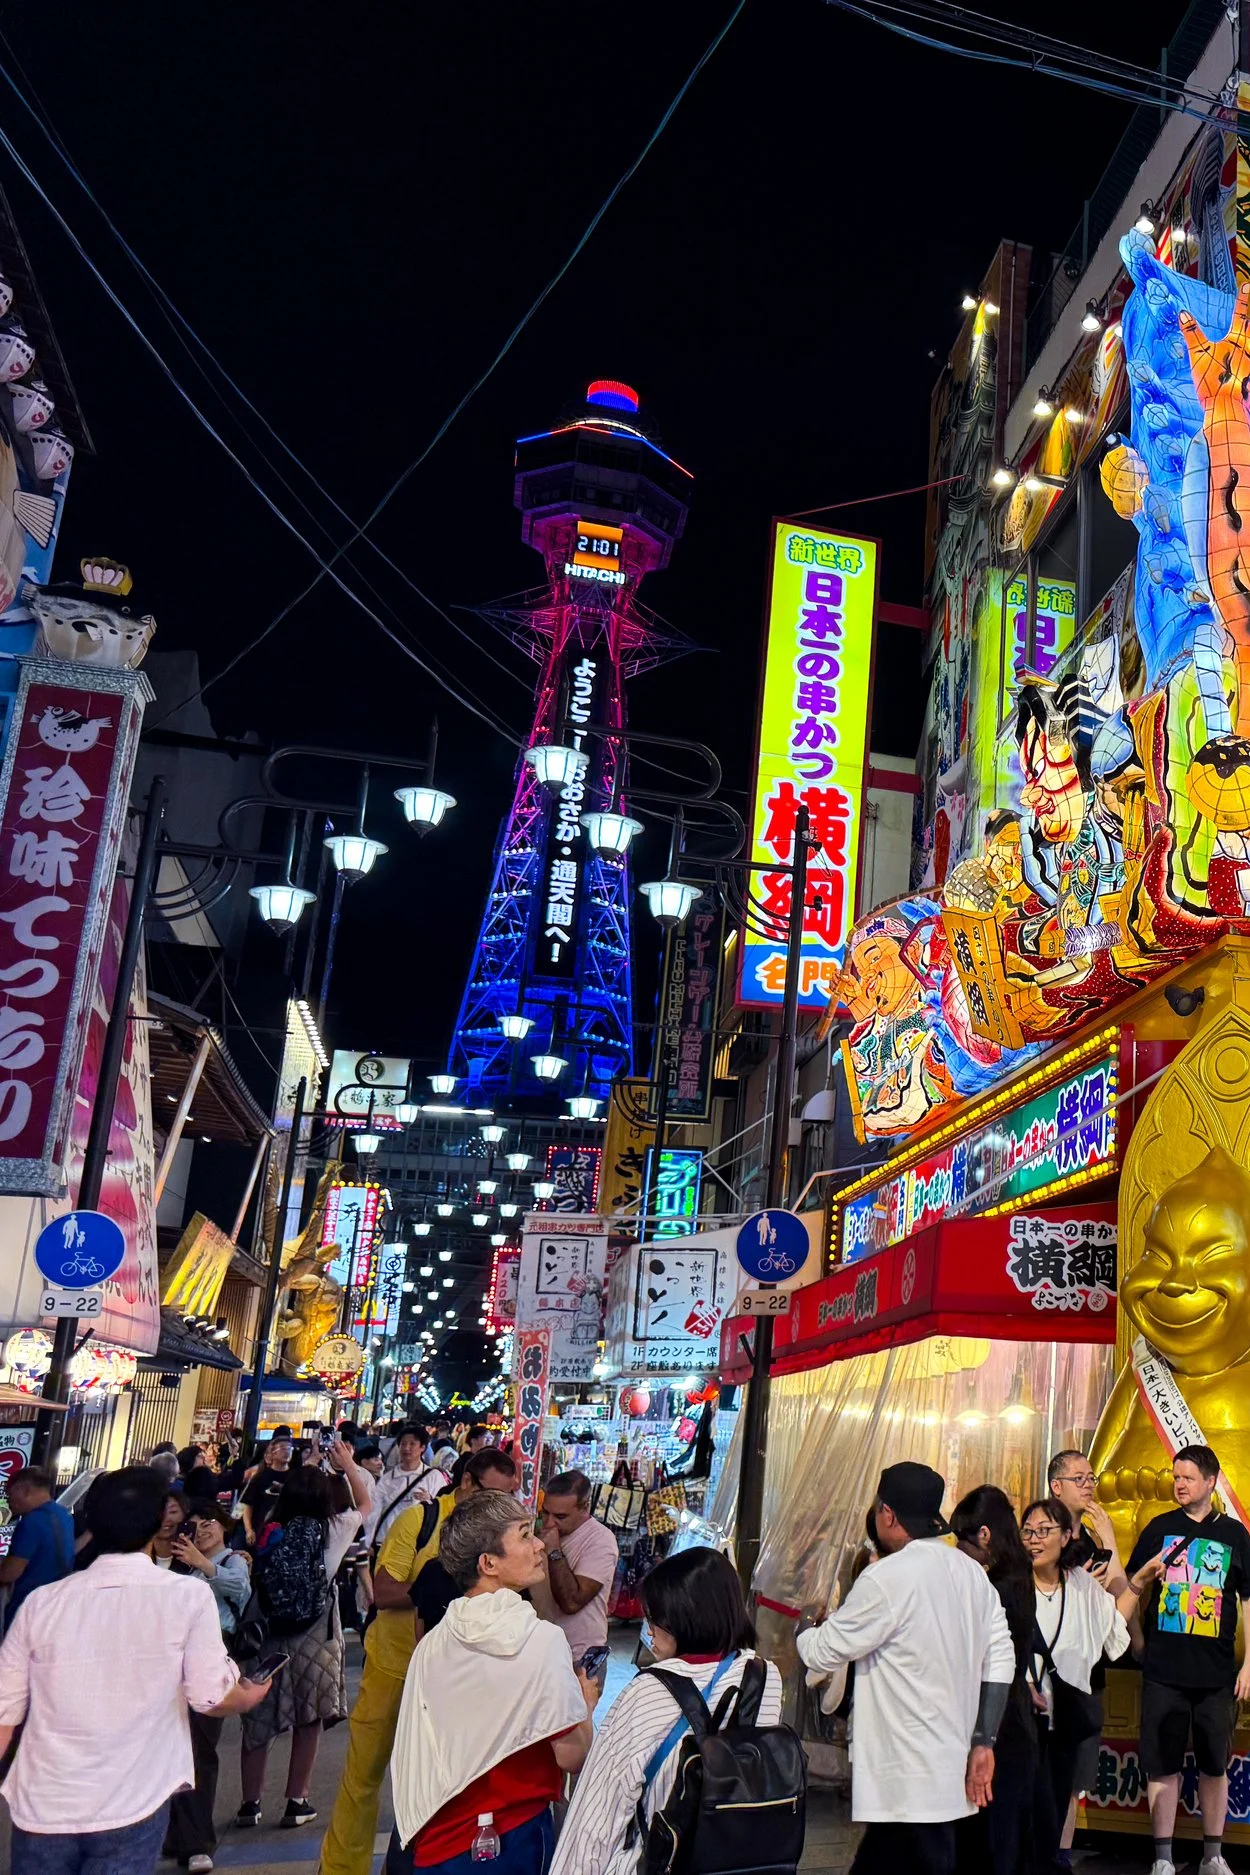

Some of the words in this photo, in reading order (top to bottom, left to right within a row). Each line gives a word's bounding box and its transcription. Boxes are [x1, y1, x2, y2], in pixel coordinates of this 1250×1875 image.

[577, 535, 619, 557] 21:01
[789, 536, 863, 573] 新世界
[564, 562, 625, 584] HITACHI
[791, 571, 843, 780] 日本一の串かつ
[763, 781, 851, 949] 横綱
[1056, 1074, 1107, 1172] 横綱
[1014, 1220, 1117, 1237] 日本一の串か
[1010, 1240, 1117, 1292] 横綱
[1035, 1291, 1085, 1307] よこづな
[633, 1346, 645, 1357] 1F
[648, 1346, 718, 1357] カウンター席
[631, 1361, 643, 1371] 2F
[647, 1360, 717, 1371] 座敷あります
